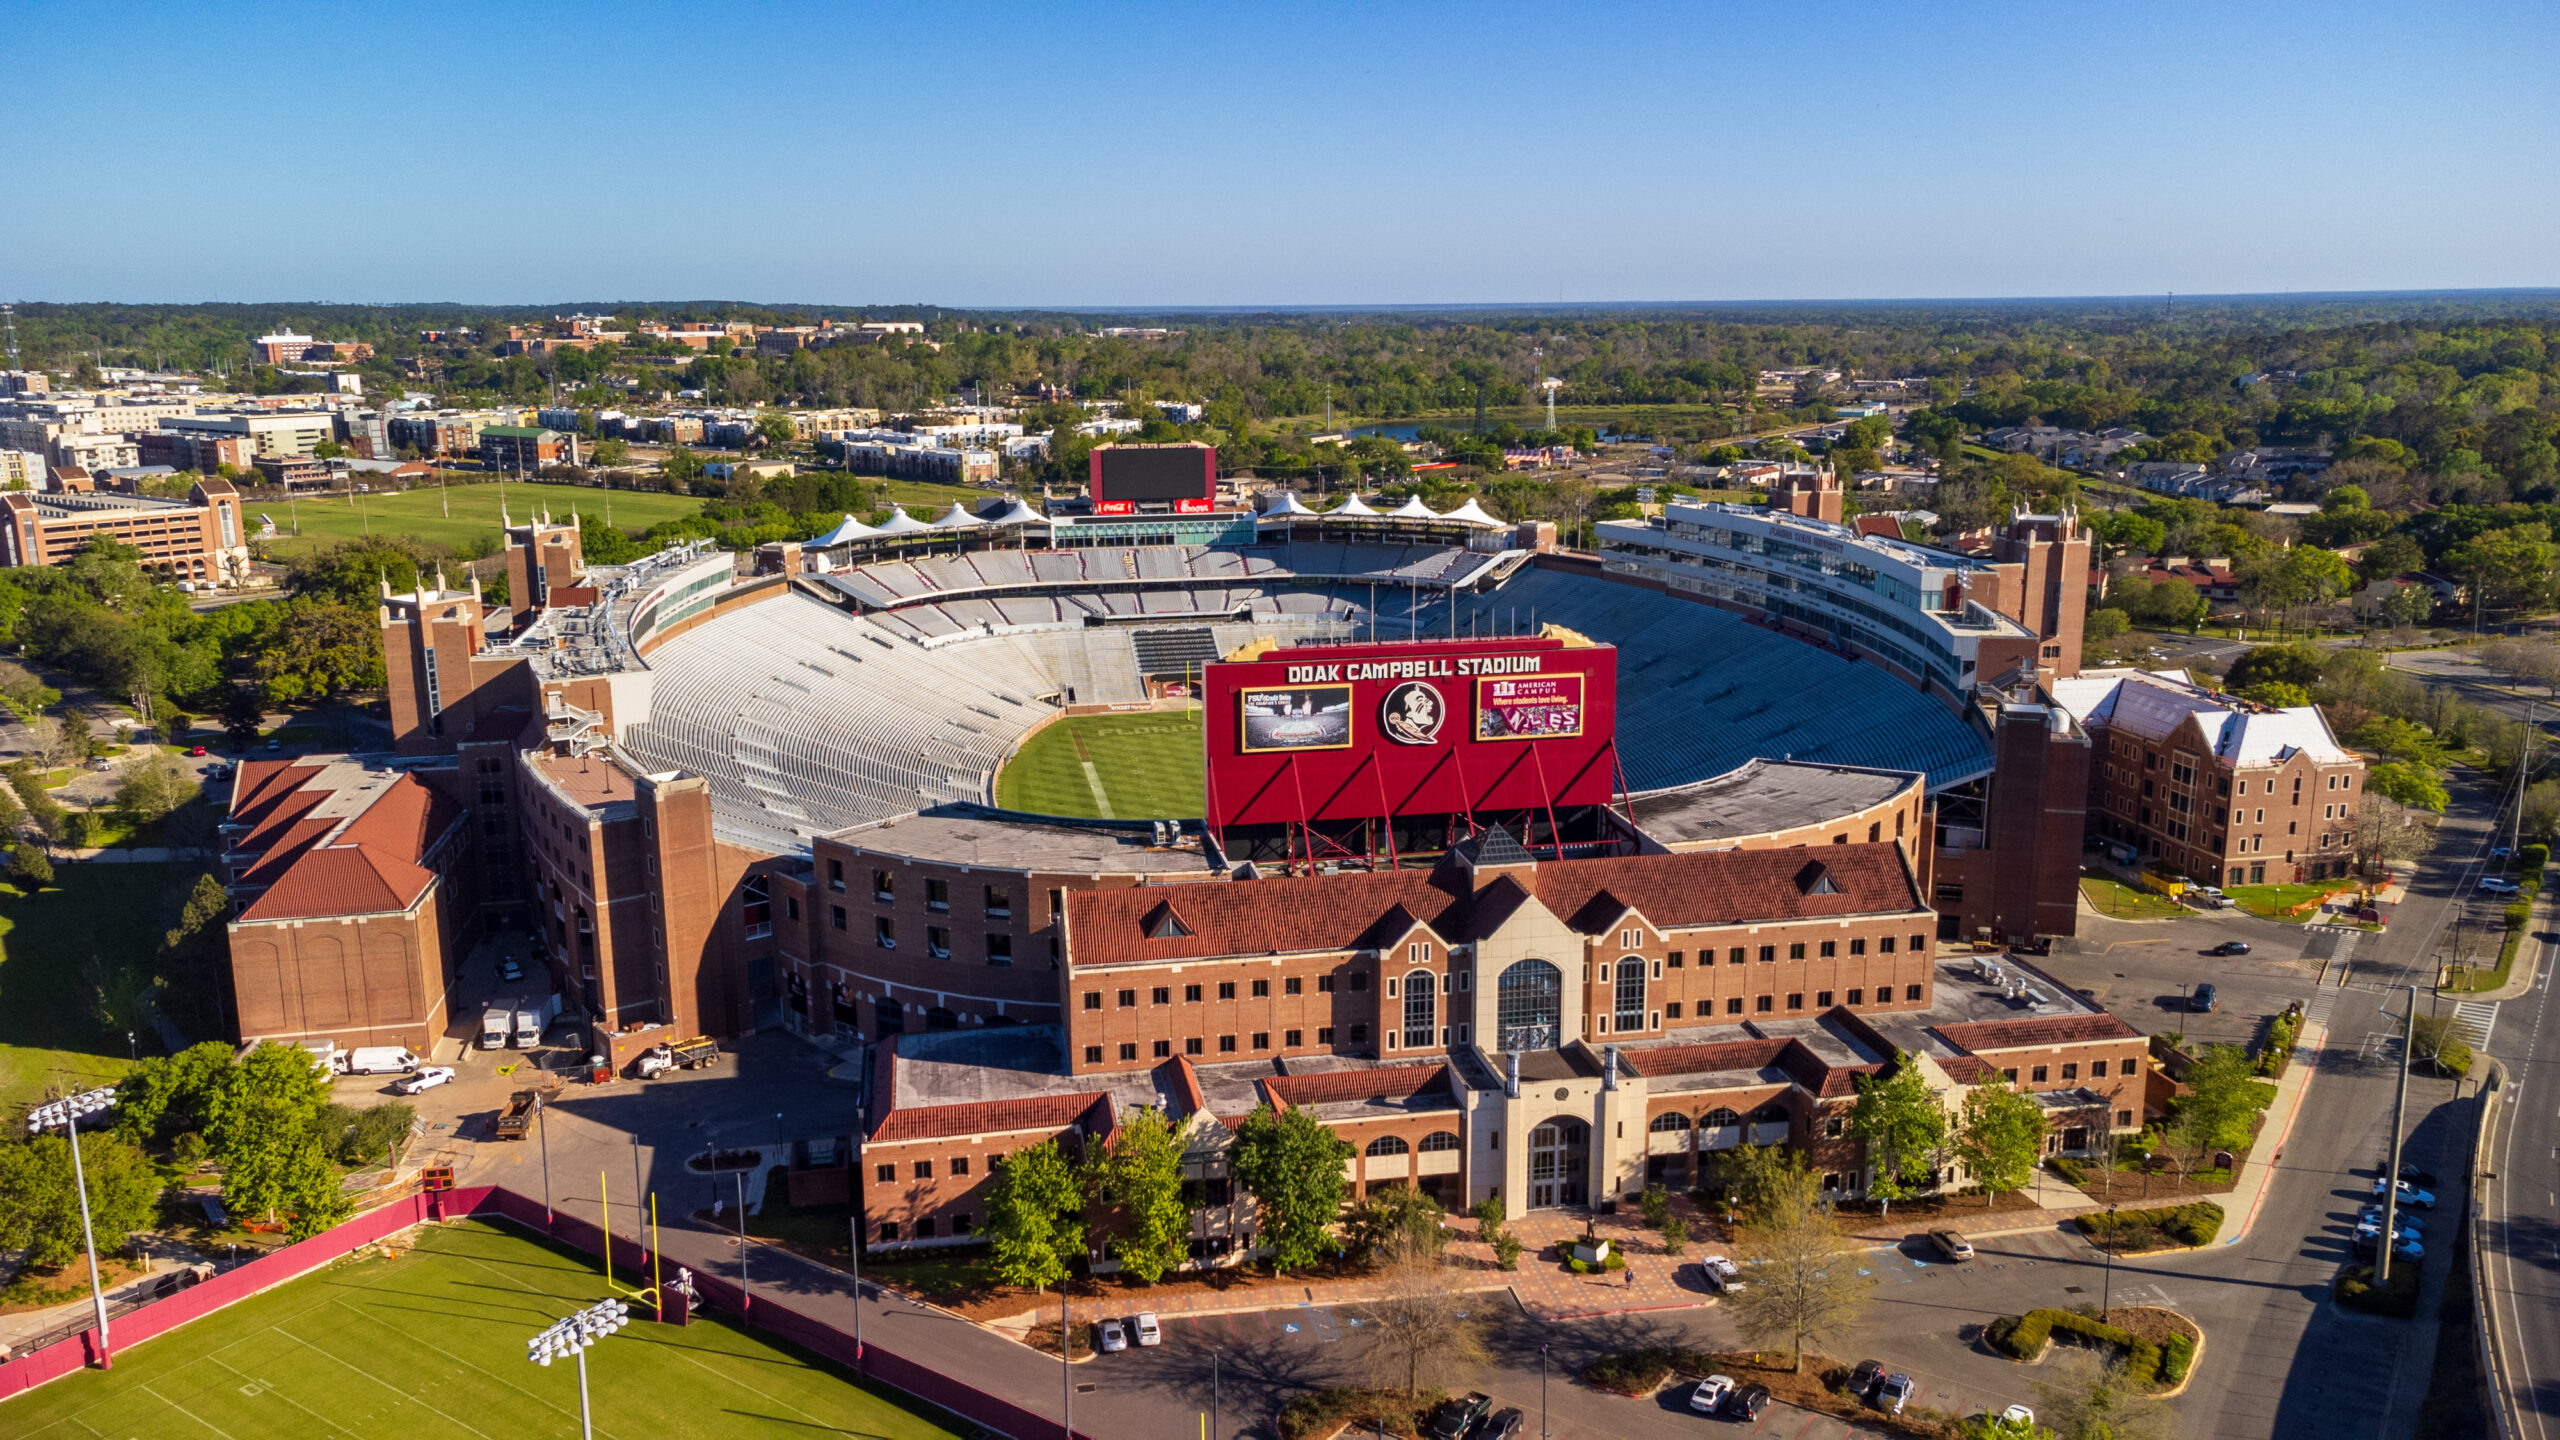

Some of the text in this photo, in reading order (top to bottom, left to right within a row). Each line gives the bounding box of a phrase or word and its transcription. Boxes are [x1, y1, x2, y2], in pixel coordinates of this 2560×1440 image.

[1288, 656, 1540, 683] DOAK CAMPBELL STADIUM
[1517, 687, 1557, 695] CAMPUS
[1493, 697, 1512, 706] Where
[1513, 697, 1537, 705] students
[1097, 724, 1202, 737] FLORID
